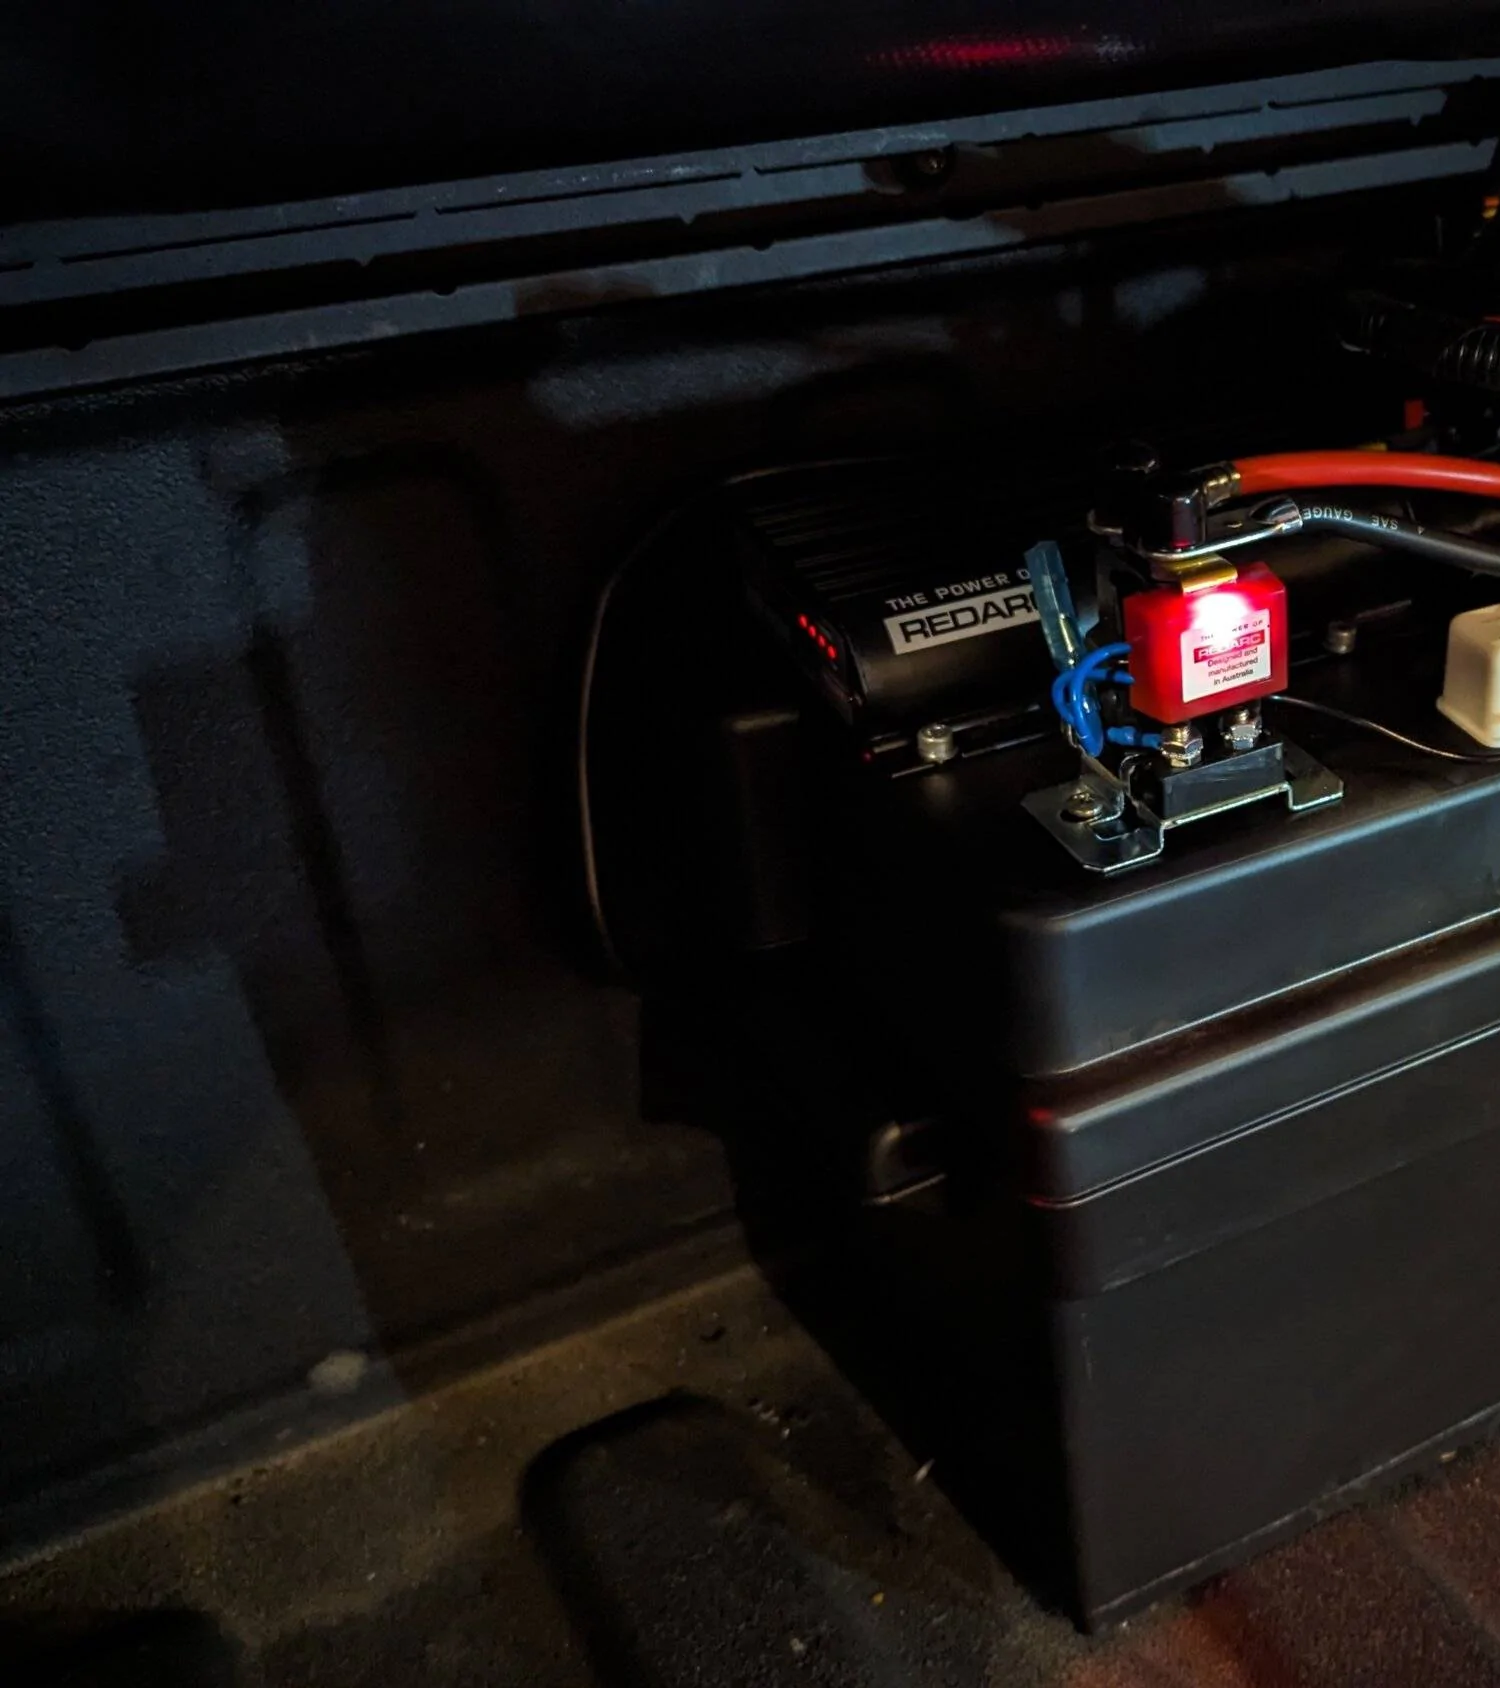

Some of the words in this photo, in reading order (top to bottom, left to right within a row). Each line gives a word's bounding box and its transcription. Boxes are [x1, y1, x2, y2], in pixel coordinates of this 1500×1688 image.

[1302, 505, 1353, 522] GAUGE
[1371, 513, 1399, 531] SAE
[885, 591, 929, 612] THE
[933, 572, 1012, 602] POWER
[899, 592, 1039, 643] REDAR
[1207, 650, 1243, 668] Designed
[1244, 646, 1258, 657] and
[1208, 657, 1259, 677] manufactured
[1213, 676, 1221, 686] in
[1222, 668, 1254, 683] Australia
